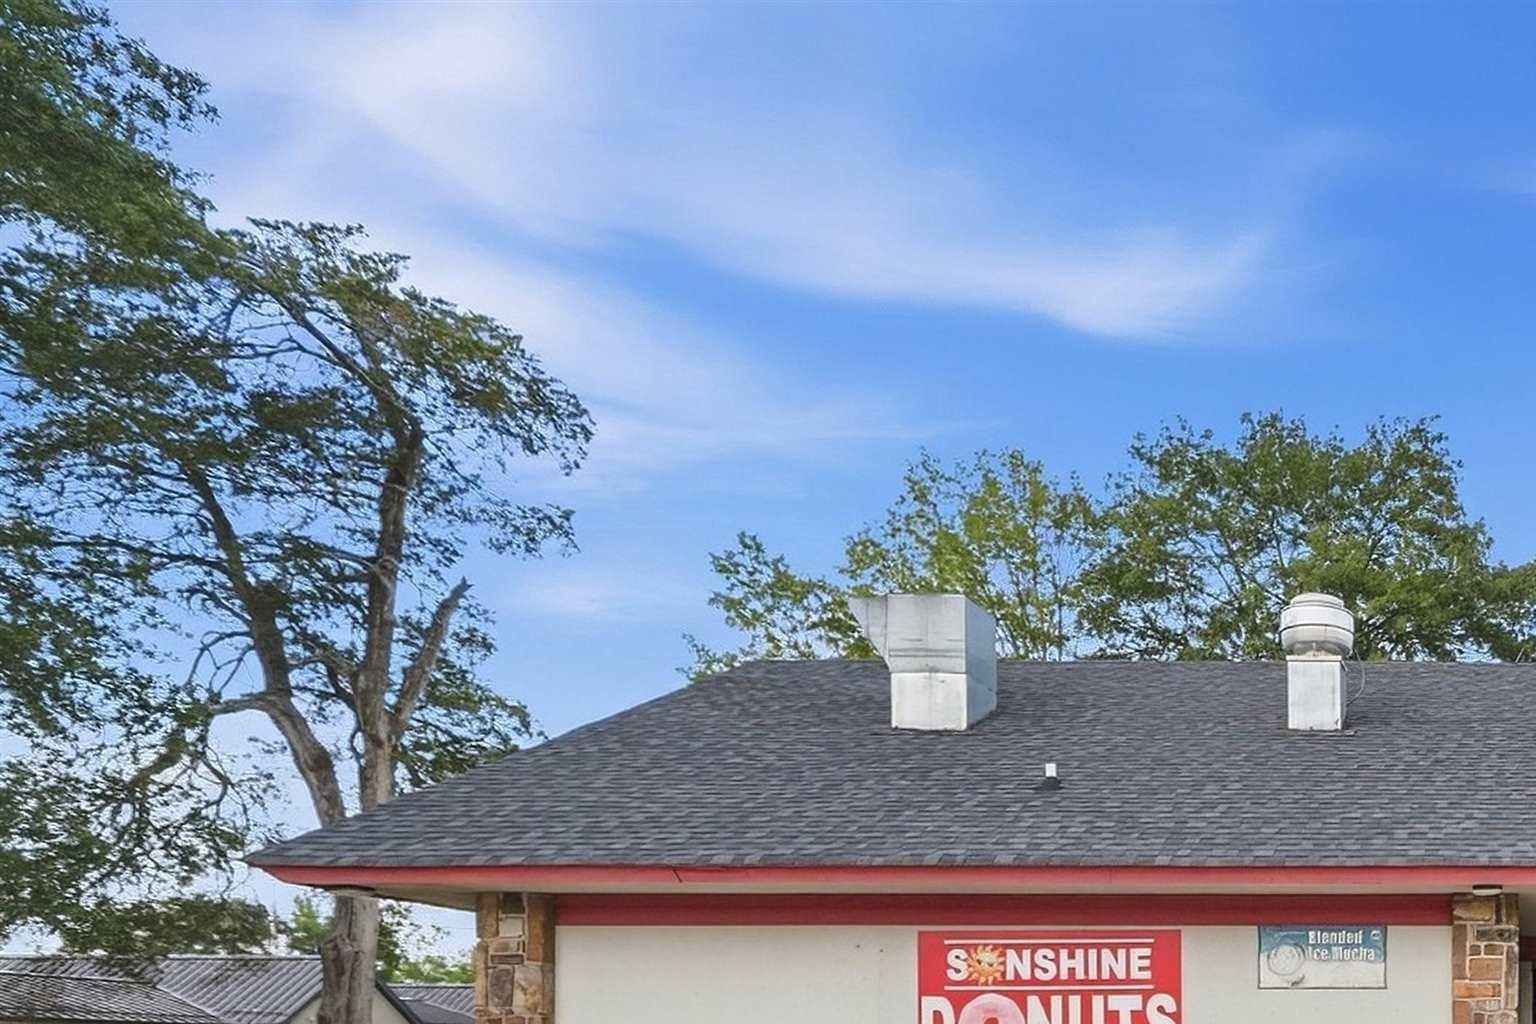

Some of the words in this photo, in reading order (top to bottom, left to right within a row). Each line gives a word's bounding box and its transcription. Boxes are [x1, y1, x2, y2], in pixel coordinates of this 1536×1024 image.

[1308, 930, 1362, 944] Blended
[1332, 946, 1375, 961] Mocha
[947, 946, 1152, 984] SNSHINE
